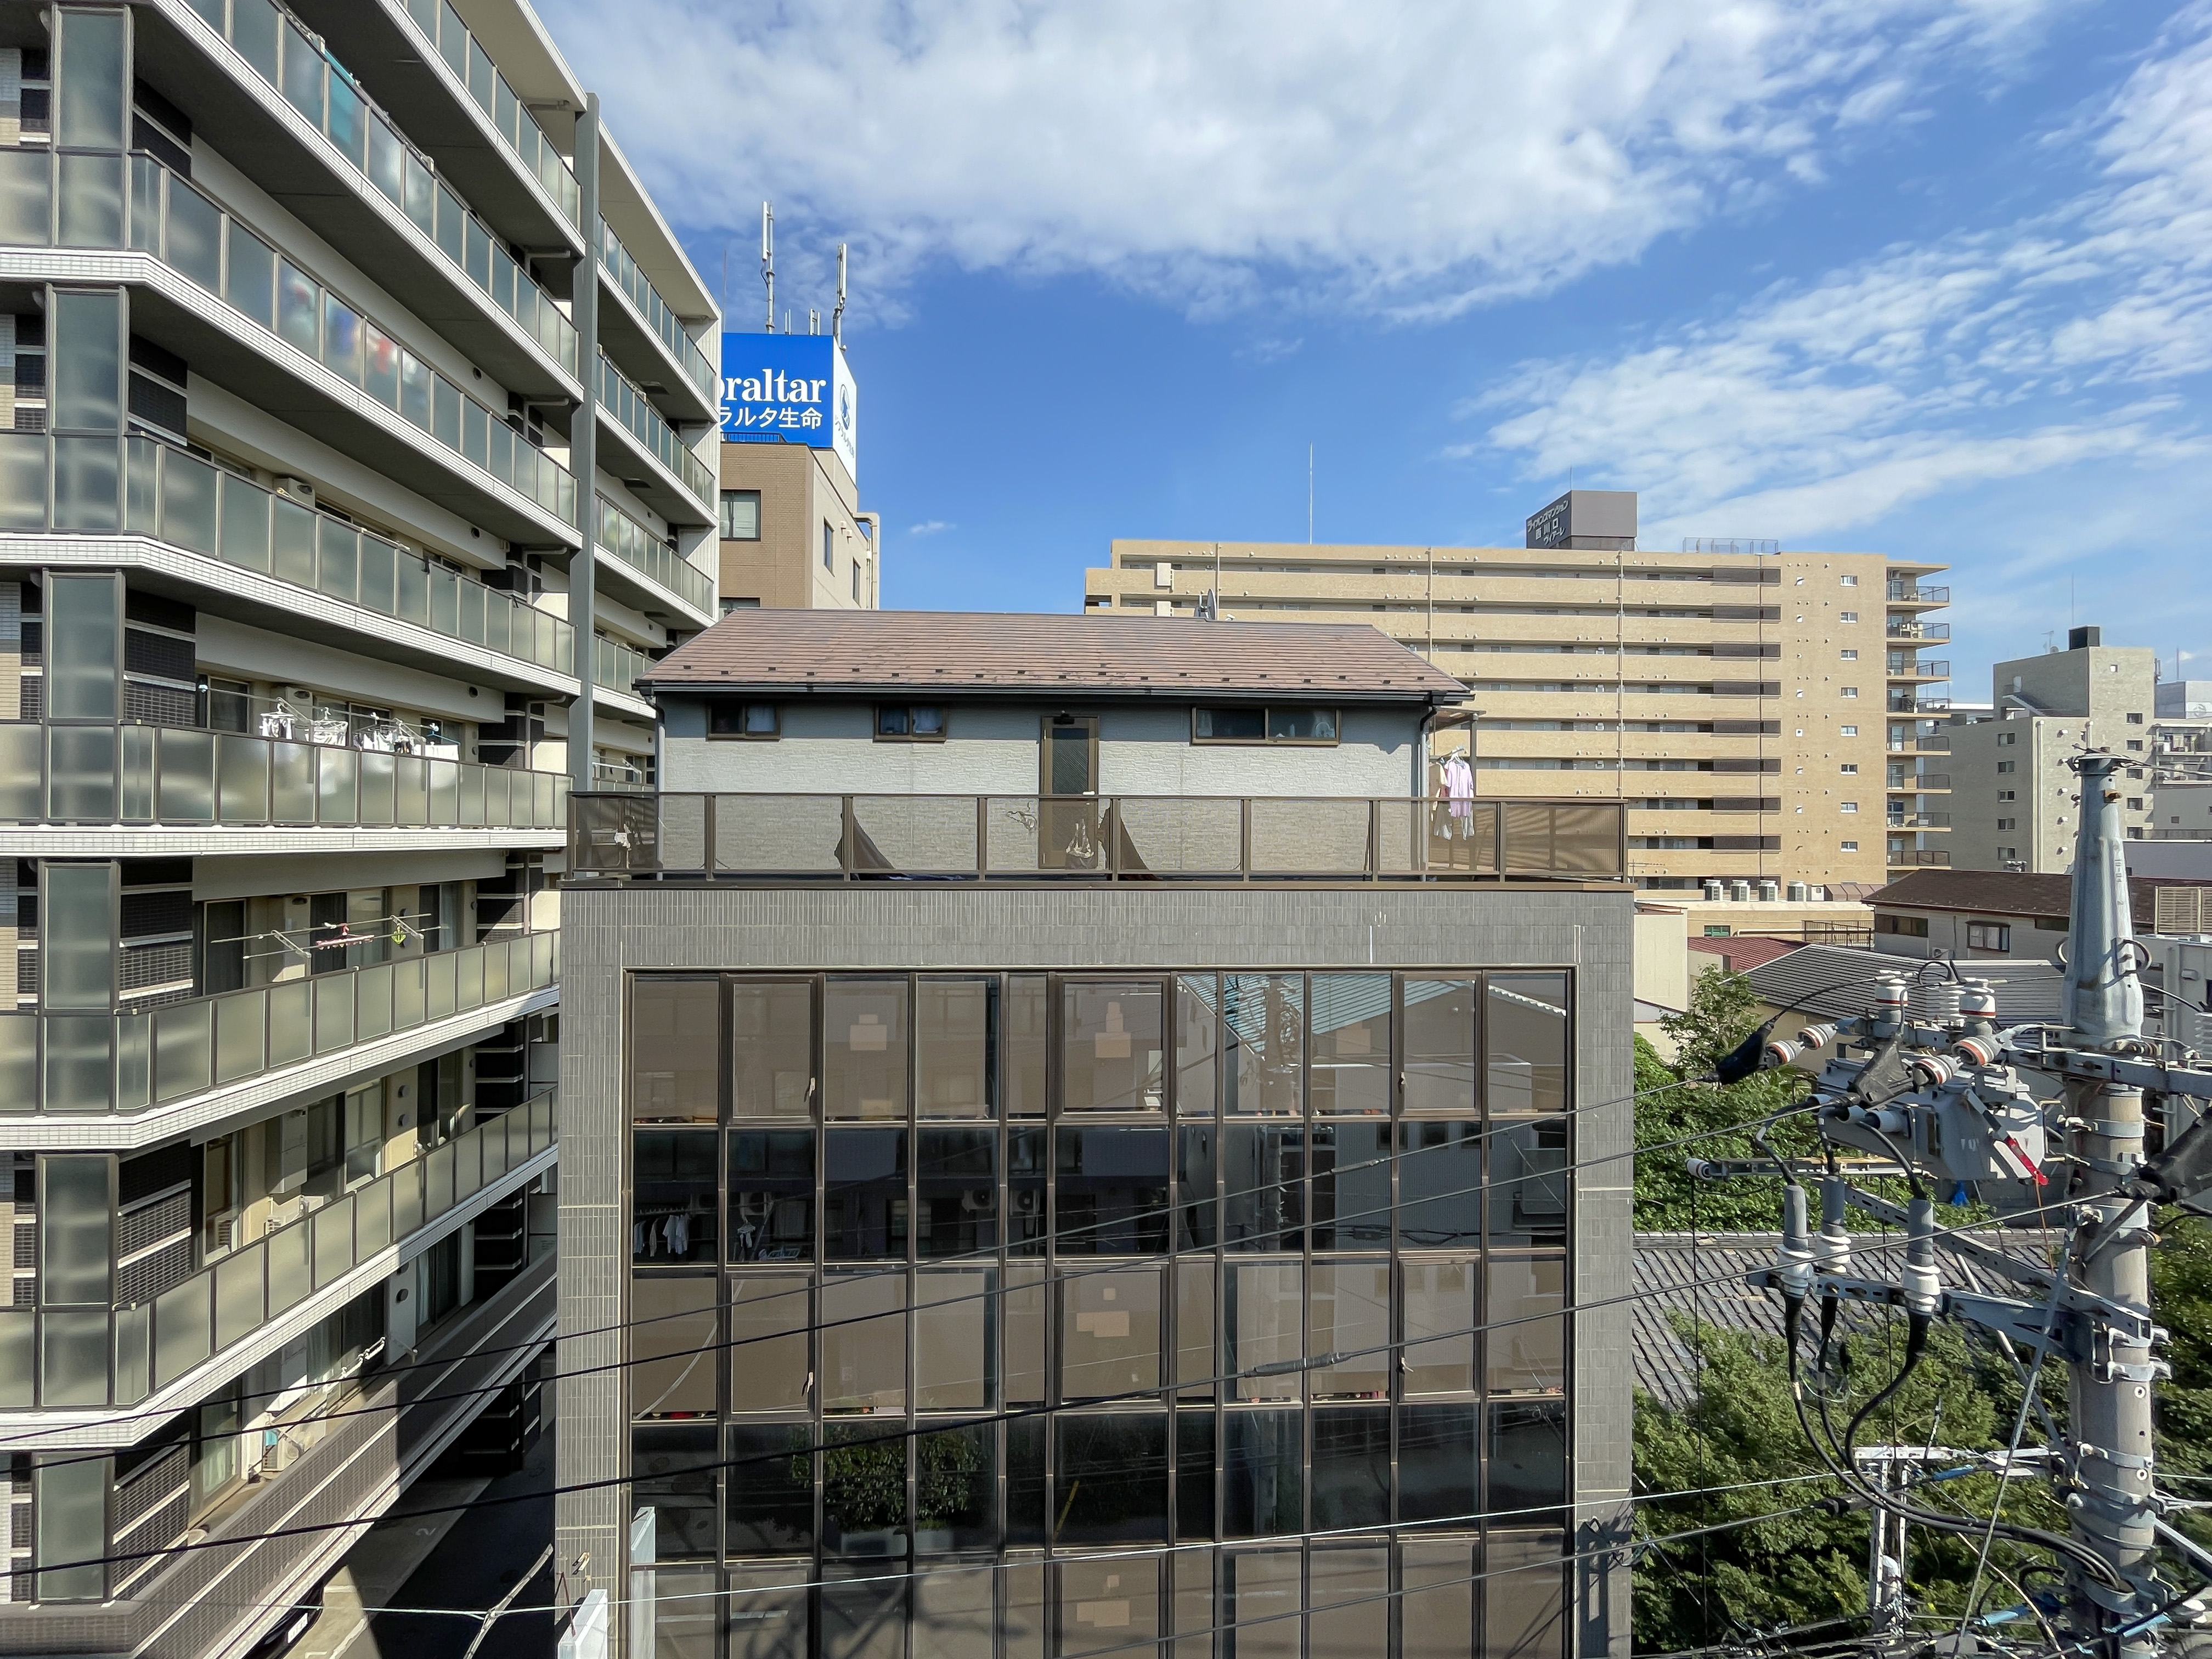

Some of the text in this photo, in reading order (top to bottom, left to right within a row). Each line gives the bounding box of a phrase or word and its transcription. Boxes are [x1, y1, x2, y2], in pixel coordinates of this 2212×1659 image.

[720, 407, 823, 430] ラルタ生命
[1527, 500, 1568, 533] ライオンズマンション
[1536, 517, 1559, 540] 西川口
